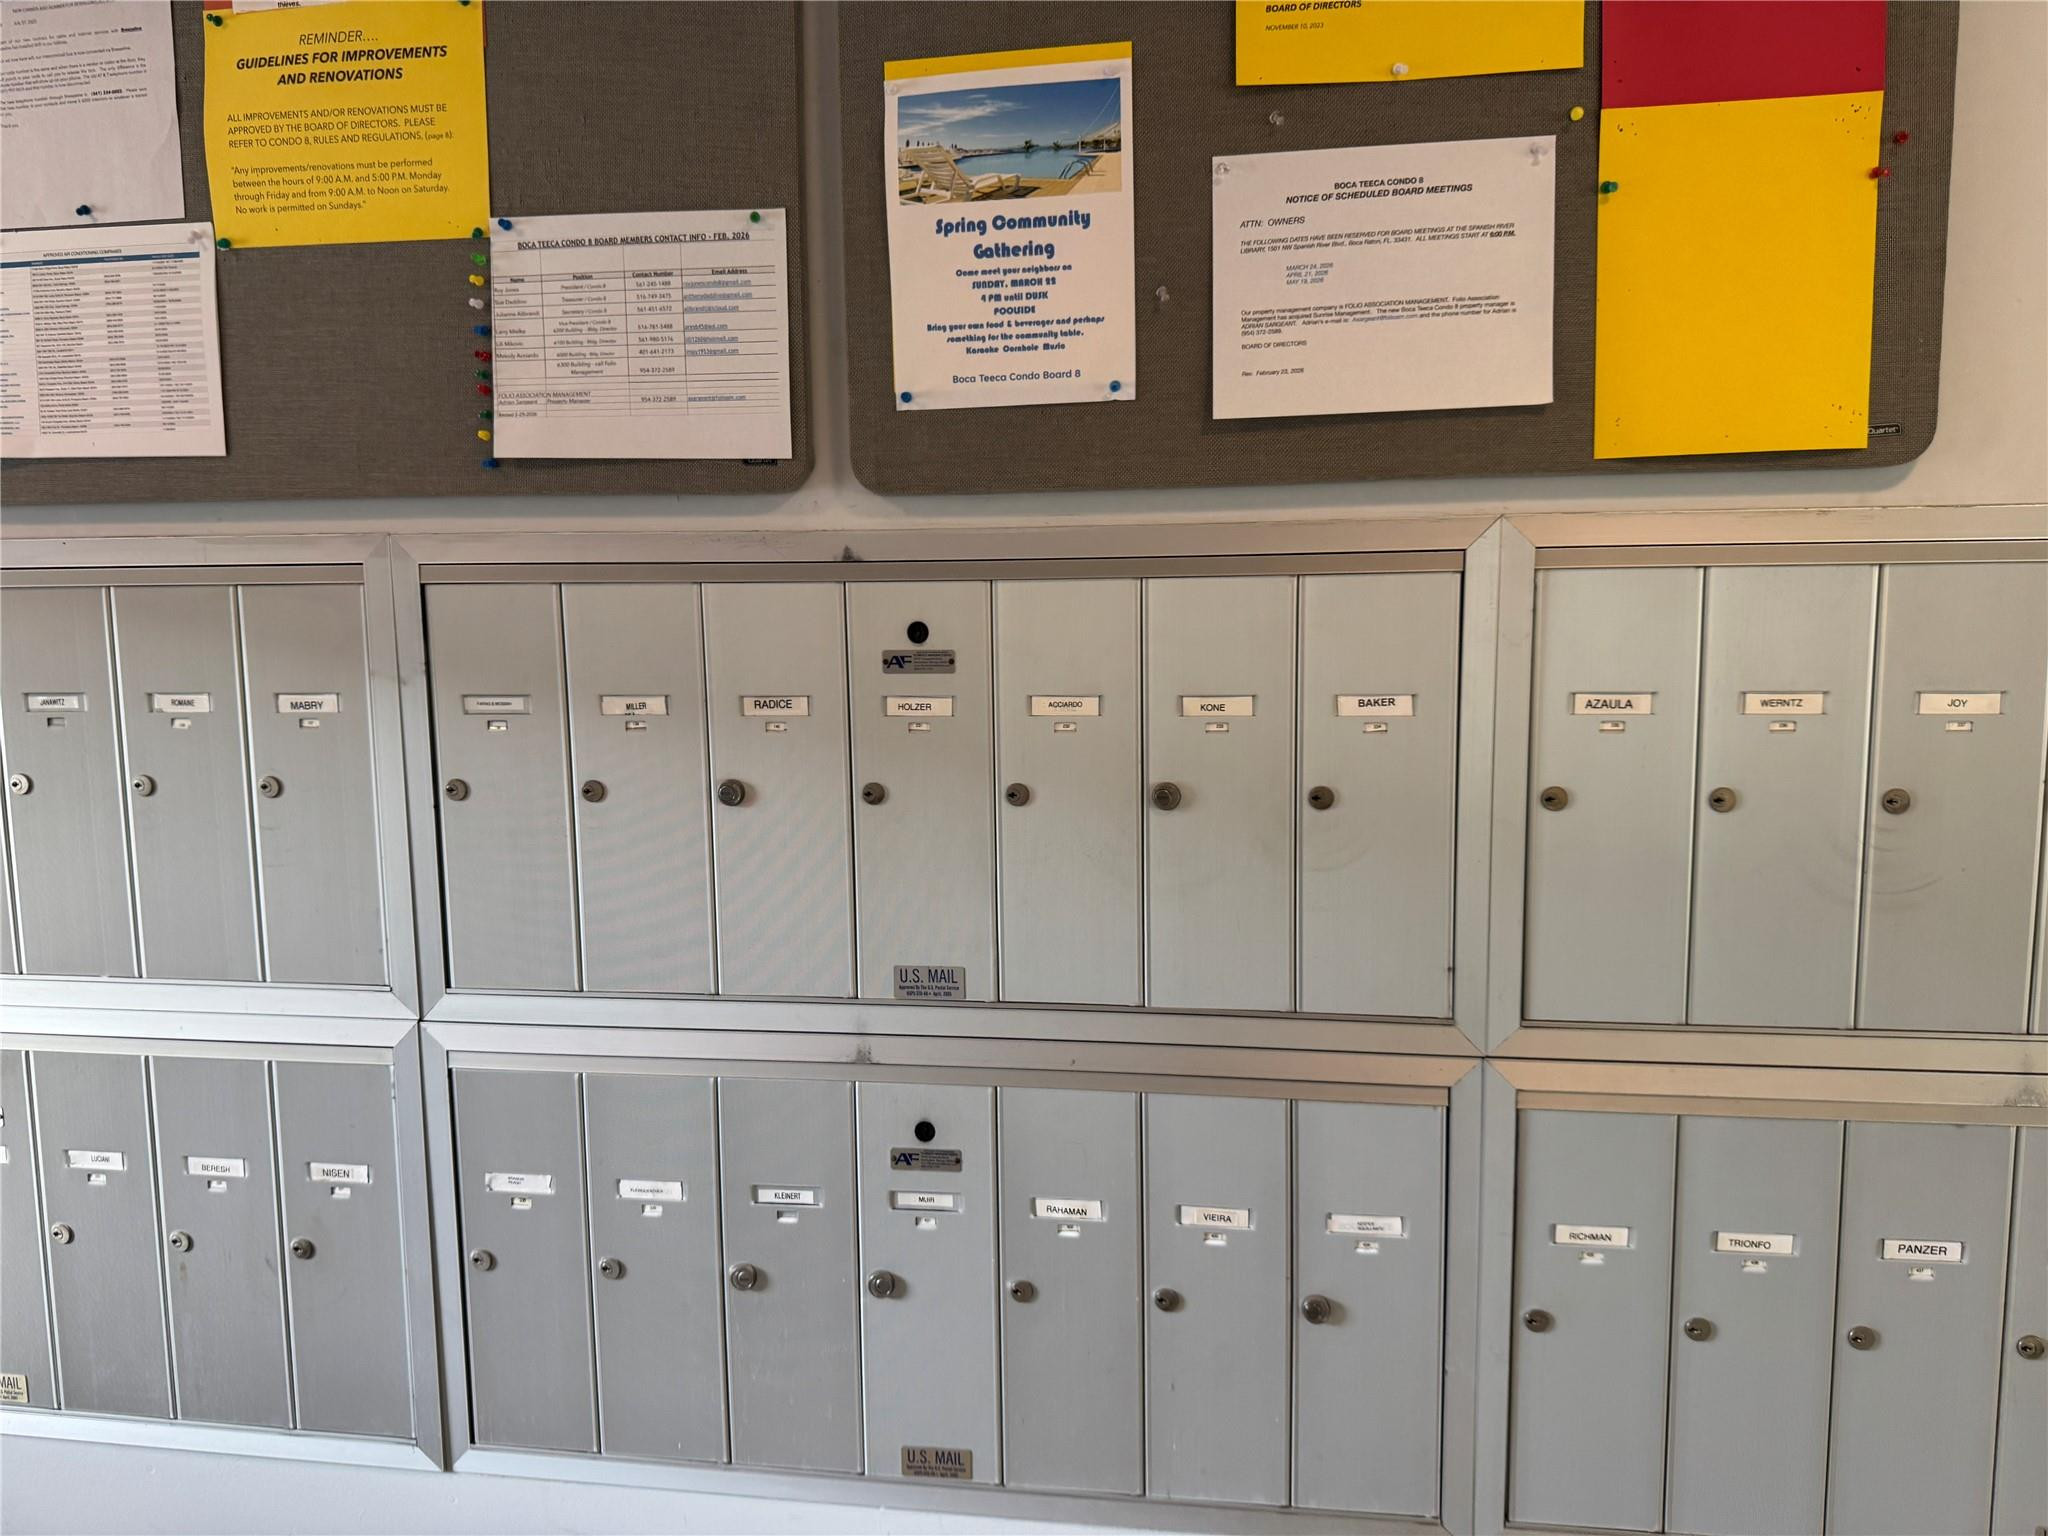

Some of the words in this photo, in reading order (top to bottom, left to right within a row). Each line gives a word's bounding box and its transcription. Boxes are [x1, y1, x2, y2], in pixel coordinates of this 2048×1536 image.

[1266, 3, 1297, 13] BOARD
[1299, 2, 1312, 11] OF
[1313, 0, 1361, 10] DIRECTORS
[236, 54, 309, 69] GUIDELINES
[312, 51, 338, 63] FOR
[342, 46, 447, 61] IMPROVEMENTS
[278, 73, 306, 85] AND
[310, 68, 402, 83] RENOVATIONS
[227, 114, 242, 122] ALL
[243, 110, 308, 121] IMPROVEMENTS
[310, 108, 345, 117] AND/OR
[347, 105, 408, 116] RENOVATIONS
[410, 104, 434, 113] MUST
[436, 103, 447, 112] BE
[228, 125, 272, 135] APPROVED
[274, 124, 284, 133] BY
[286, 123, 302, 132] THE
[304, 122, 334, 132] BOARD
[336, 121, 348, 130] OF
[350, 119, 400, 129] DIRECTORS.
[404, 117, 435, 126] PLEASE
[229, 139, 254, 148] REFER
[255, 138, 267, 147] TO
[268, 137, 302, 147] CONDO
[313, 135, 339, 144] RULES
[340, 134, 360, 143] AND
[362, 131, 423, 142] REGULATIONS,
[232, 166, 248, 176] "Any
[251, 163, 354, 175] improvements/renovations
[357, 161, 375, 169] must
[378, 160, 388, 168] be
[390, 158, 432, 169] performed
[232, 180, 266, 188] between
[268, 178, 280, 186] the
[282, 177, 304, 186] hours
[305, 175, 314, 185] of
[316, 175, 334, 184] 9:00
[334, 174, 353, 183] A.M.
[355, 174, 370, 182] and
[372, 172, 390, 182] 5:00
[391, 172, 408, 180] P.M.
[409, 171, 442, 180] Monday
[1334, 182, 1357, 190] BOCA
[1359, 180, 1385, 188] TEECA
[1387, 177, 1417, 186] CONDO
[234, 192, 265, 202] through
[266, 191, 290, 201] Friday
[292, 190, 306, 198] and
[308, 189, 327, 197] from
[328, 188, 346, 197] 9:00
[347, 187, 365, 196] A.M.
[377, 186, 399, 194] Noon
[414, 184, 450, 193] Saturday.
[1286, 194, 1319, 204] NOTICE
[1321, 193, 1334, 201] OF
[1335, 189, 1390, 200] SCHEDULED
[1392, 187, 1424, 196] BOARD
[1426, 184, 1472, 193] MEETINGS
[236, 206, 247, 214] No
[249, 204, 267, 214] work
[270, 205, 275, 213] is
[277, 203, 315, 213] permitted
[329, 200, 366, 210] Sundays."
[936, 218, 987, 237] Spring
[992, 211, 1090, 230] Community
[1240, 220, 1263, 228] ATTN:
[1268, 216, 1305, 226] OWNERS
[518, 241, 537, 250] BOCA
[538, 240, 560, 250] TEECA
[562, 239, 585, 248] CONDO
[595, 237, 618, 246] BOARD
[620, 236, 653, 245] MEMBERS
[655, 234, 686, 244] CONTACT
[690, 233, 706, 243] INFO
[714, 232, 729, 242] FEB.
[732, 232, 749, 241] 2026
[974, 242, 1054, 259] Gathering
[956, 269, 979, 277] Come
[980, 267, 1000, 275] meet
[1002, 268, 1020, 276] your
[1022, 265, 1060, 274] neighbors
[972, 280, 1008, 289] SUNDAY,
[1010, 278, 1043, 287] MARCH
[981, 294, 986, 302] 4
[989, 294, 1001, 302] PM
[1004, 292, 1023, 301] until
[1026, 291, 1048, 300] DUSK
[994, 306, 1035, 315] POOLSIDE
[927, 324, 946, 333] Bring
[949, 324, 966, 332] your
[1056, 317, 1071, 325] and
[1073, 316, 1104, 325] perhaps
[946, 334, 986, 343] something
[1015, 330, 1058, 339] community
[1060, 329, 1084, 337] table.
[966, 346, 999, 354] Karaoke
[1002, 344, 1039, 352] Cornhole
[953, 375, 976, 384] Boca
[979, 374, 1006, 382] Teeca
[1009, 372, 1040, 381] Condo
[1043, 370, 1072, 379] Board
[1075, 369, 1081, 378] 8
[290, 701, 324, 711] MABRY
[625, 702, 647, 710] MILLER
[754, 699, 793, 709] RADICE
[897, 703, 932, 711] HOLZER
[1200, 703, 1226, 712] KONE
[1357, 697, 1396, 708] BAKER
[1584, 698, 1633, 709] AZAULA
[1760, 698, 1803, 708] WERNTZ
[1947, 698, 1967, 708] JOY
[900, 968, 924, 983] U.S.
[928, 968, 958, 983] MAIL
[322, 1167, 351, 1178] NISEN
[774, 1191, 801, 1200] KLEINERT
[1046, 1205, 1088, 1217] RAHAMAN
[1203, 1213, 1232, 1224] VIEIRA
[1569, 1231, 1613, 1242] RICHMAN
[1728, 1238, 1772, 1250] TRIONFO
[1898, 1243, 1948, 1256] PANZER
[907, 1448, 931, 1464] U.S.
[935, 1450, 965, 1466] MAIL
